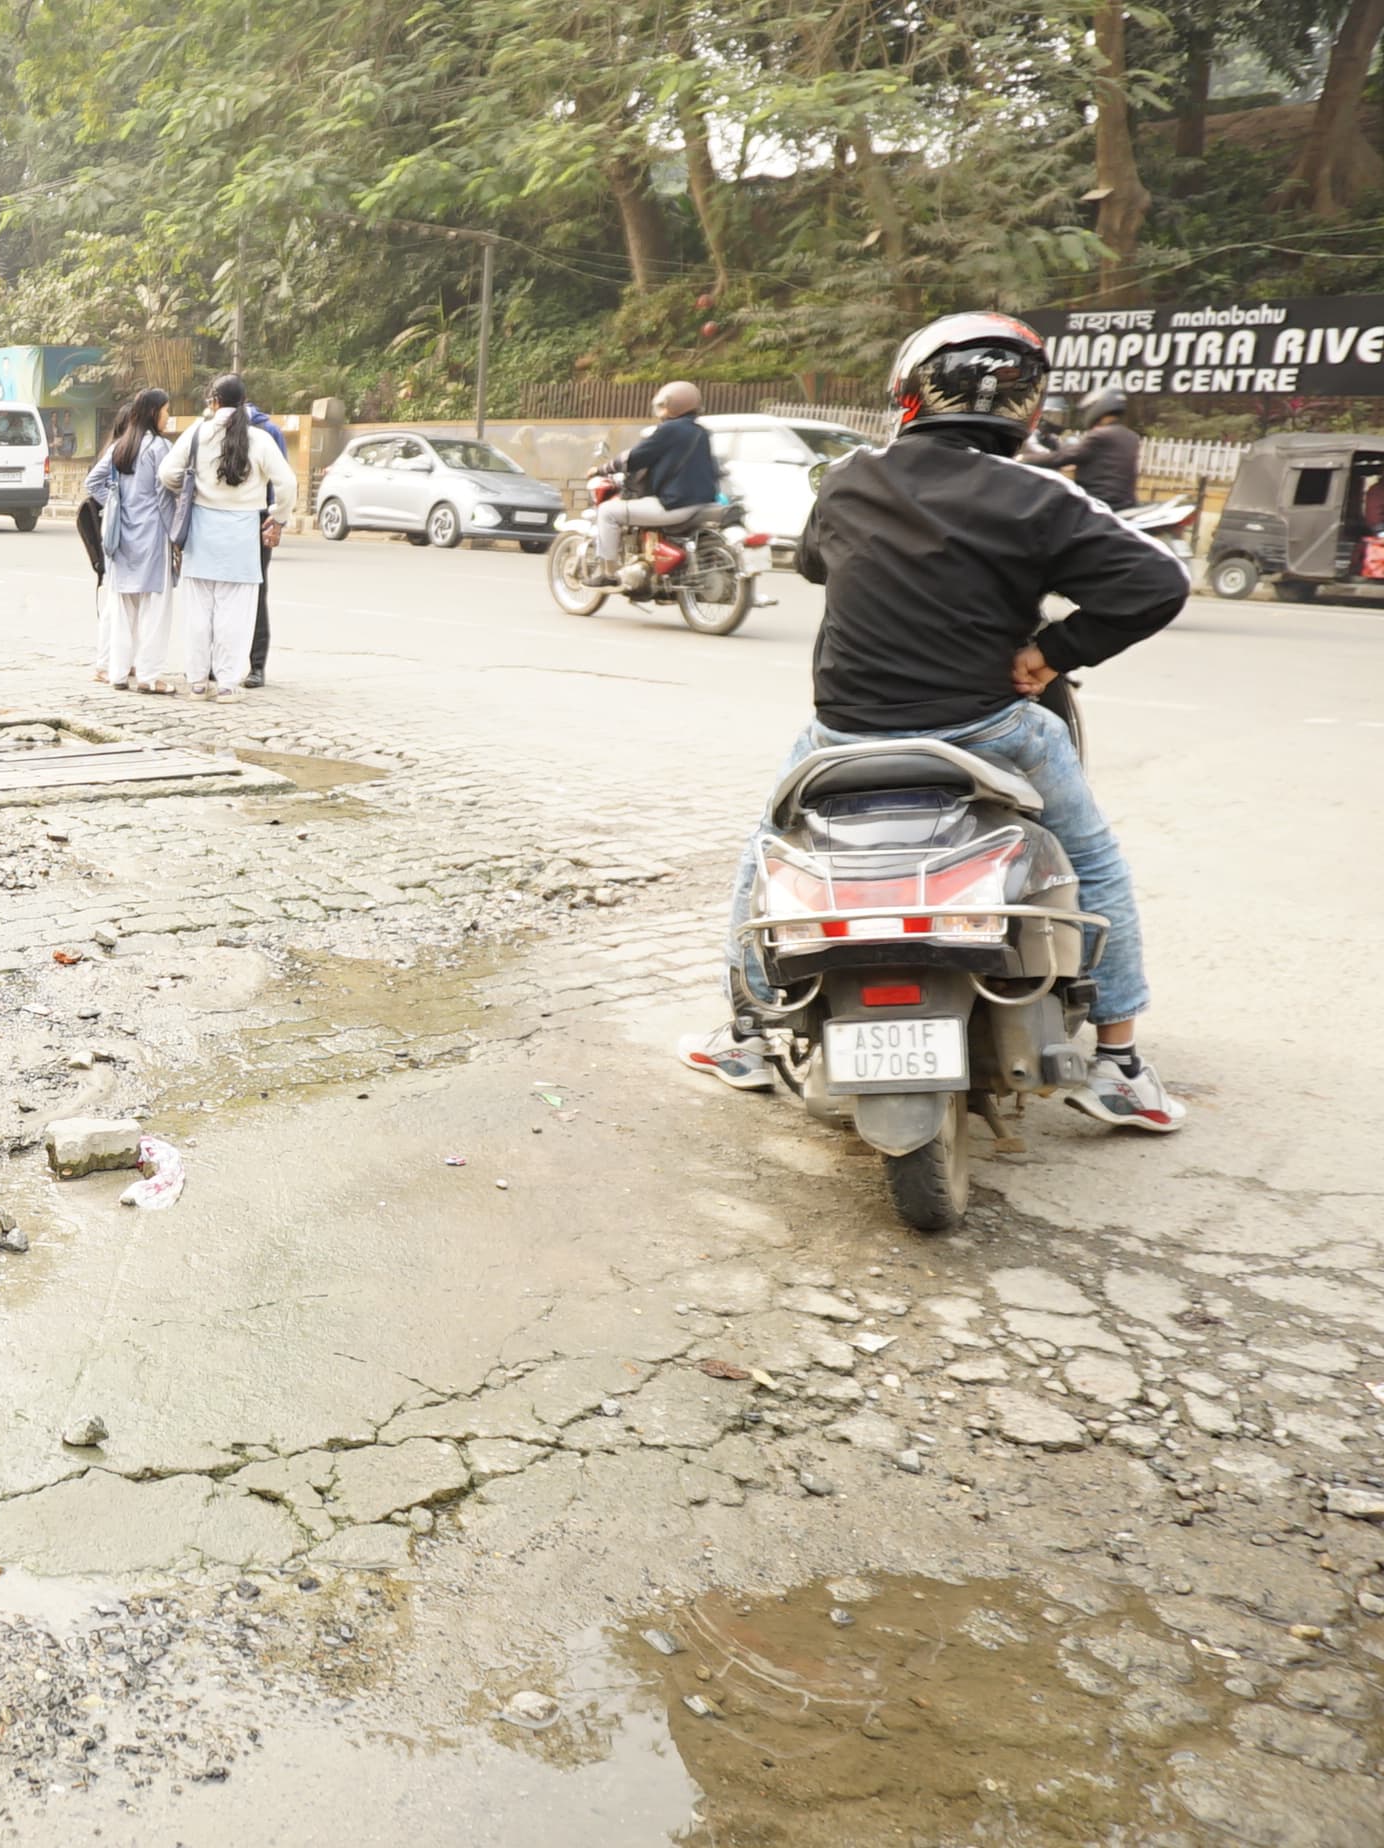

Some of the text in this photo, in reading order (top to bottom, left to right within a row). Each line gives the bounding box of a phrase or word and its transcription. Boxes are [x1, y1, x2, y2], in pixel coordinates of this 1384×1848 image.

[1171, 304, 1287, 327] mahabahu
[1272, 326, 1384, 364] RIVE
[1172, 368, 1298, 392] CENTRE
[856, 1023, 935, 1050] AS01F
[855, 1050, 938, 1078] U7069
